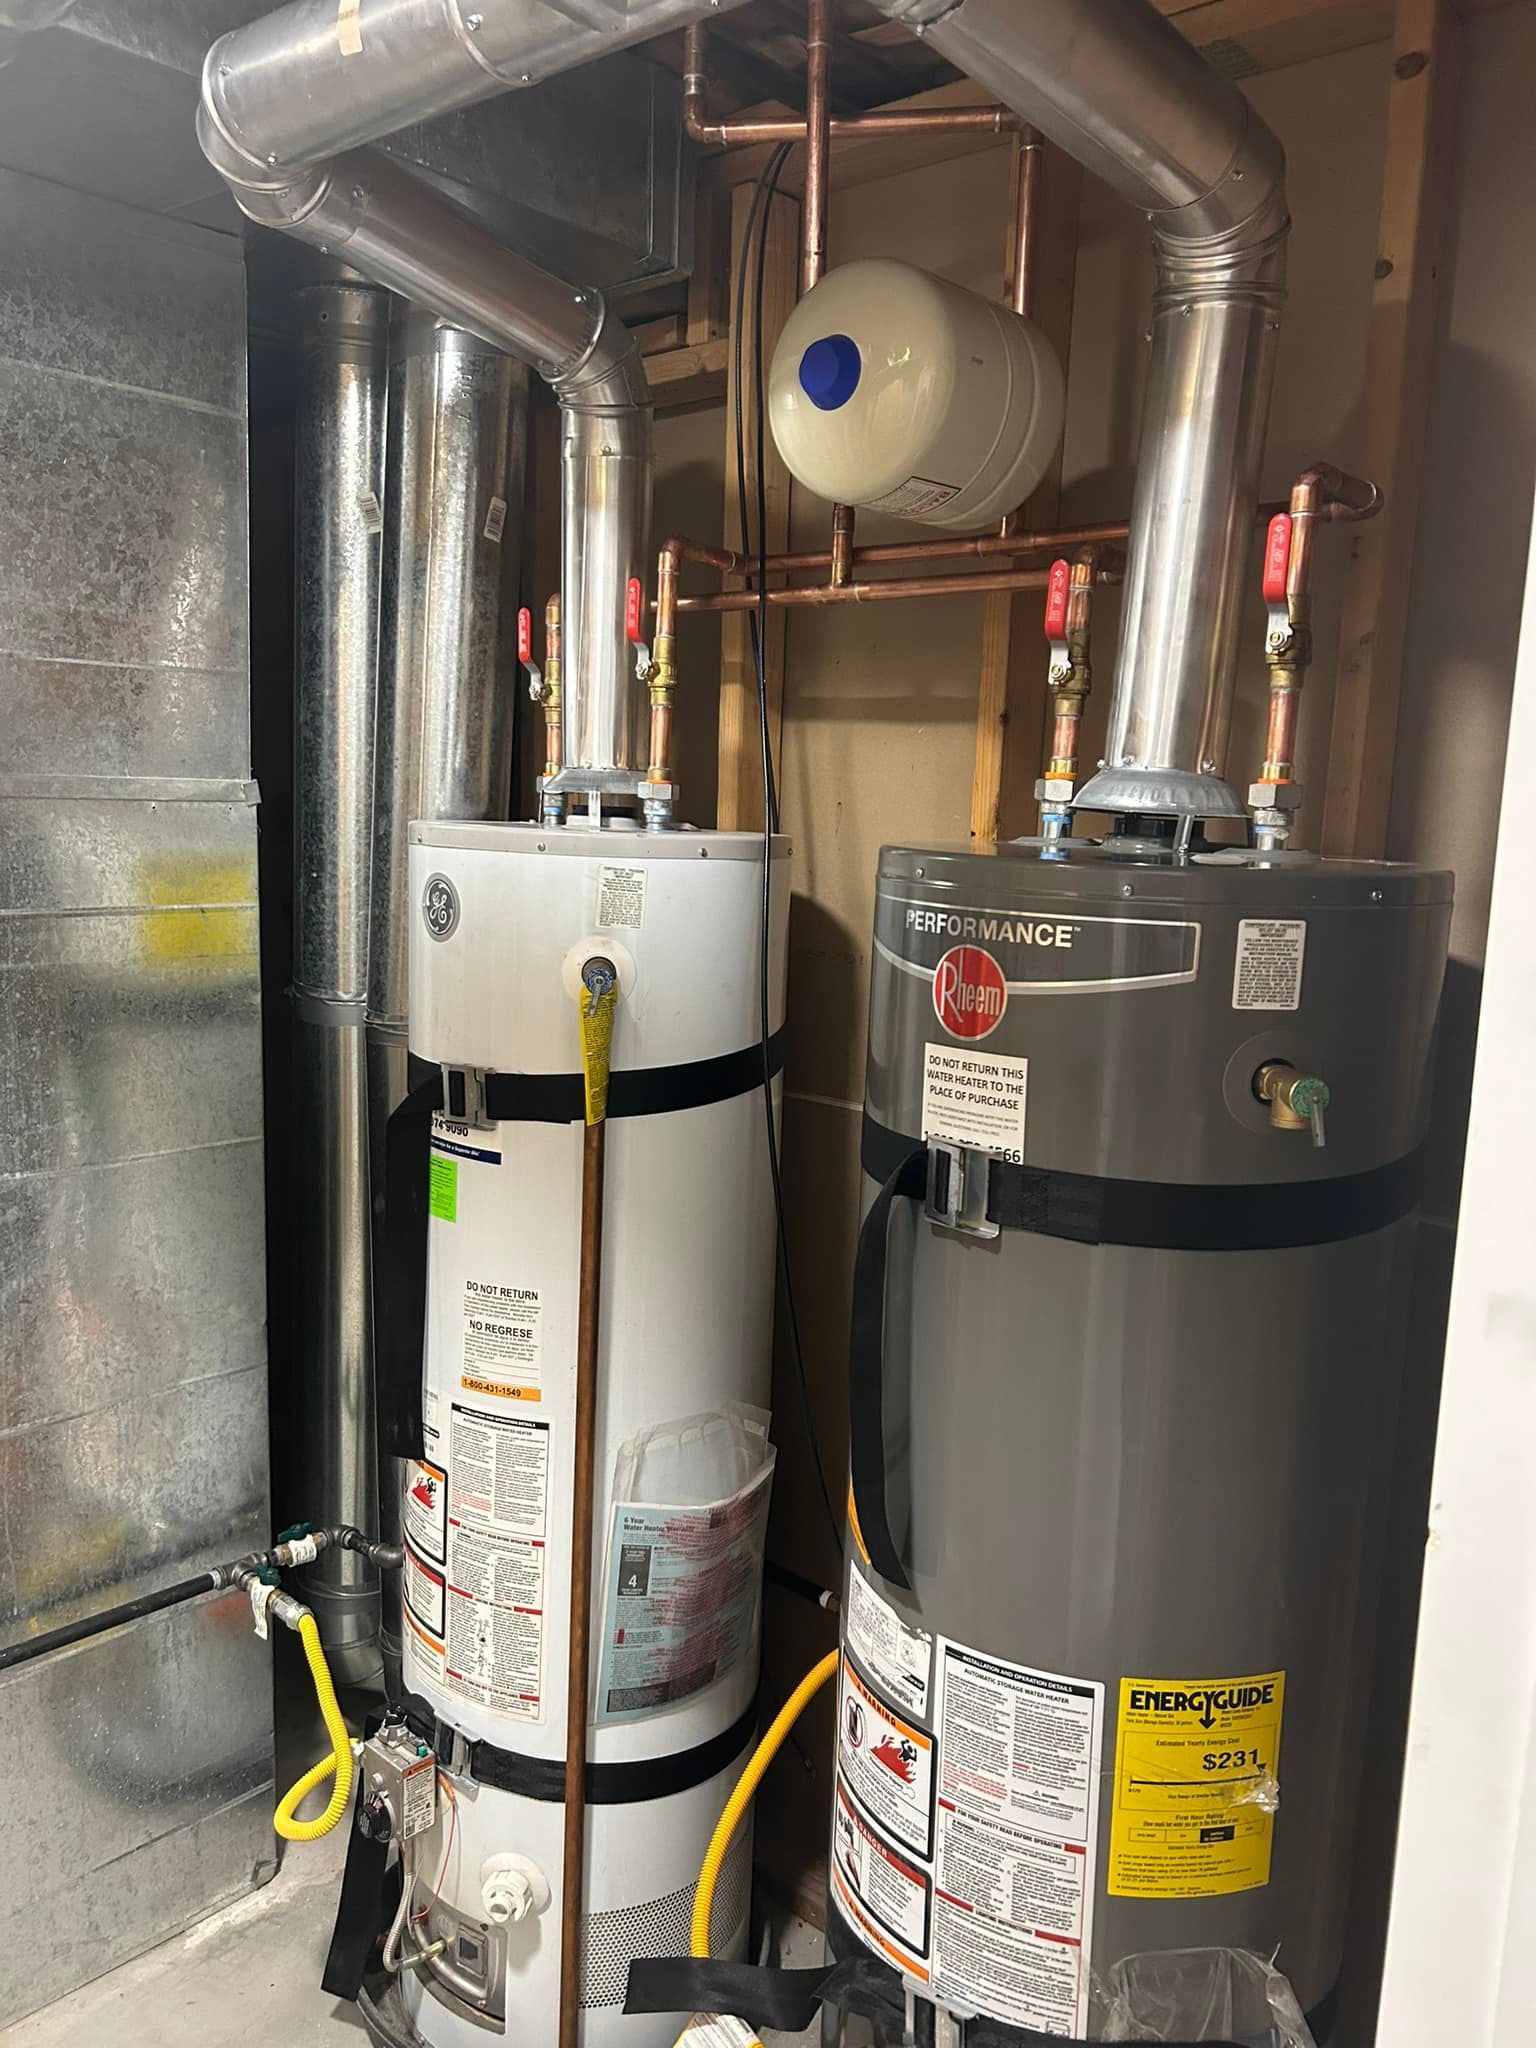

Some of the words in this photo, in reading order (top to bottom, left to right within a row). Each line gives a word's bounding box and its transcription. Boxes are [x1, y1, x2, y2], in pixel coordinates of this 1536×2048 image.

[940, 949, 1000, 1023] Rheem
[929, 1055, 941, 1066] DO
[942, 1058, 960, 1070] NOT
[961, 1061, 999, 1077] RETURN
[1002, 1067, 1024, 1080] THIS
[927, 1069, 953, 1084] WATER
[955, 1075, 988, 1090] HEATER
[990, 1081, 1003, 1092] TO
[1005, 1083, 1024, 1095] THE
[929, 1085, 953, 1098] PLACE
[954, 1090, 967, 1101] OF
[968, 1093, 1019, 1110] PURCHASE
[466, 1280, 479, 1292] DO
[480, 1283, 498, 1296] NOT
[500, 1287, 538, 1301] RETURN
[469, 1319, 483, 1331] NO
[484, 1323, 533, 1339] REGRESE
[464, 1378, 521, 1398] 1-800-431-1549
[628, 1574, 638, 1588] 4
[962, 1655, 1000, 1673] INSTALLATION
[1000, 1669, 1014, 1678] AND
[1014, 1673, 1047, 1688] OPERATION
[1048, 1681, 1073, 1693] DETAILS
[964, 1668, 997, 1685] AUTOMATIC
[997, 1680, 1023, 1693] STORAGE
[1024, 1687, 1045, 1699] WATER
[1045, 1692, 1070, 1705] HEATER
[1130, 1683, 1275, 1712] ENERGYGUIDE
[1202, 1748, 1259, 1771] $231
